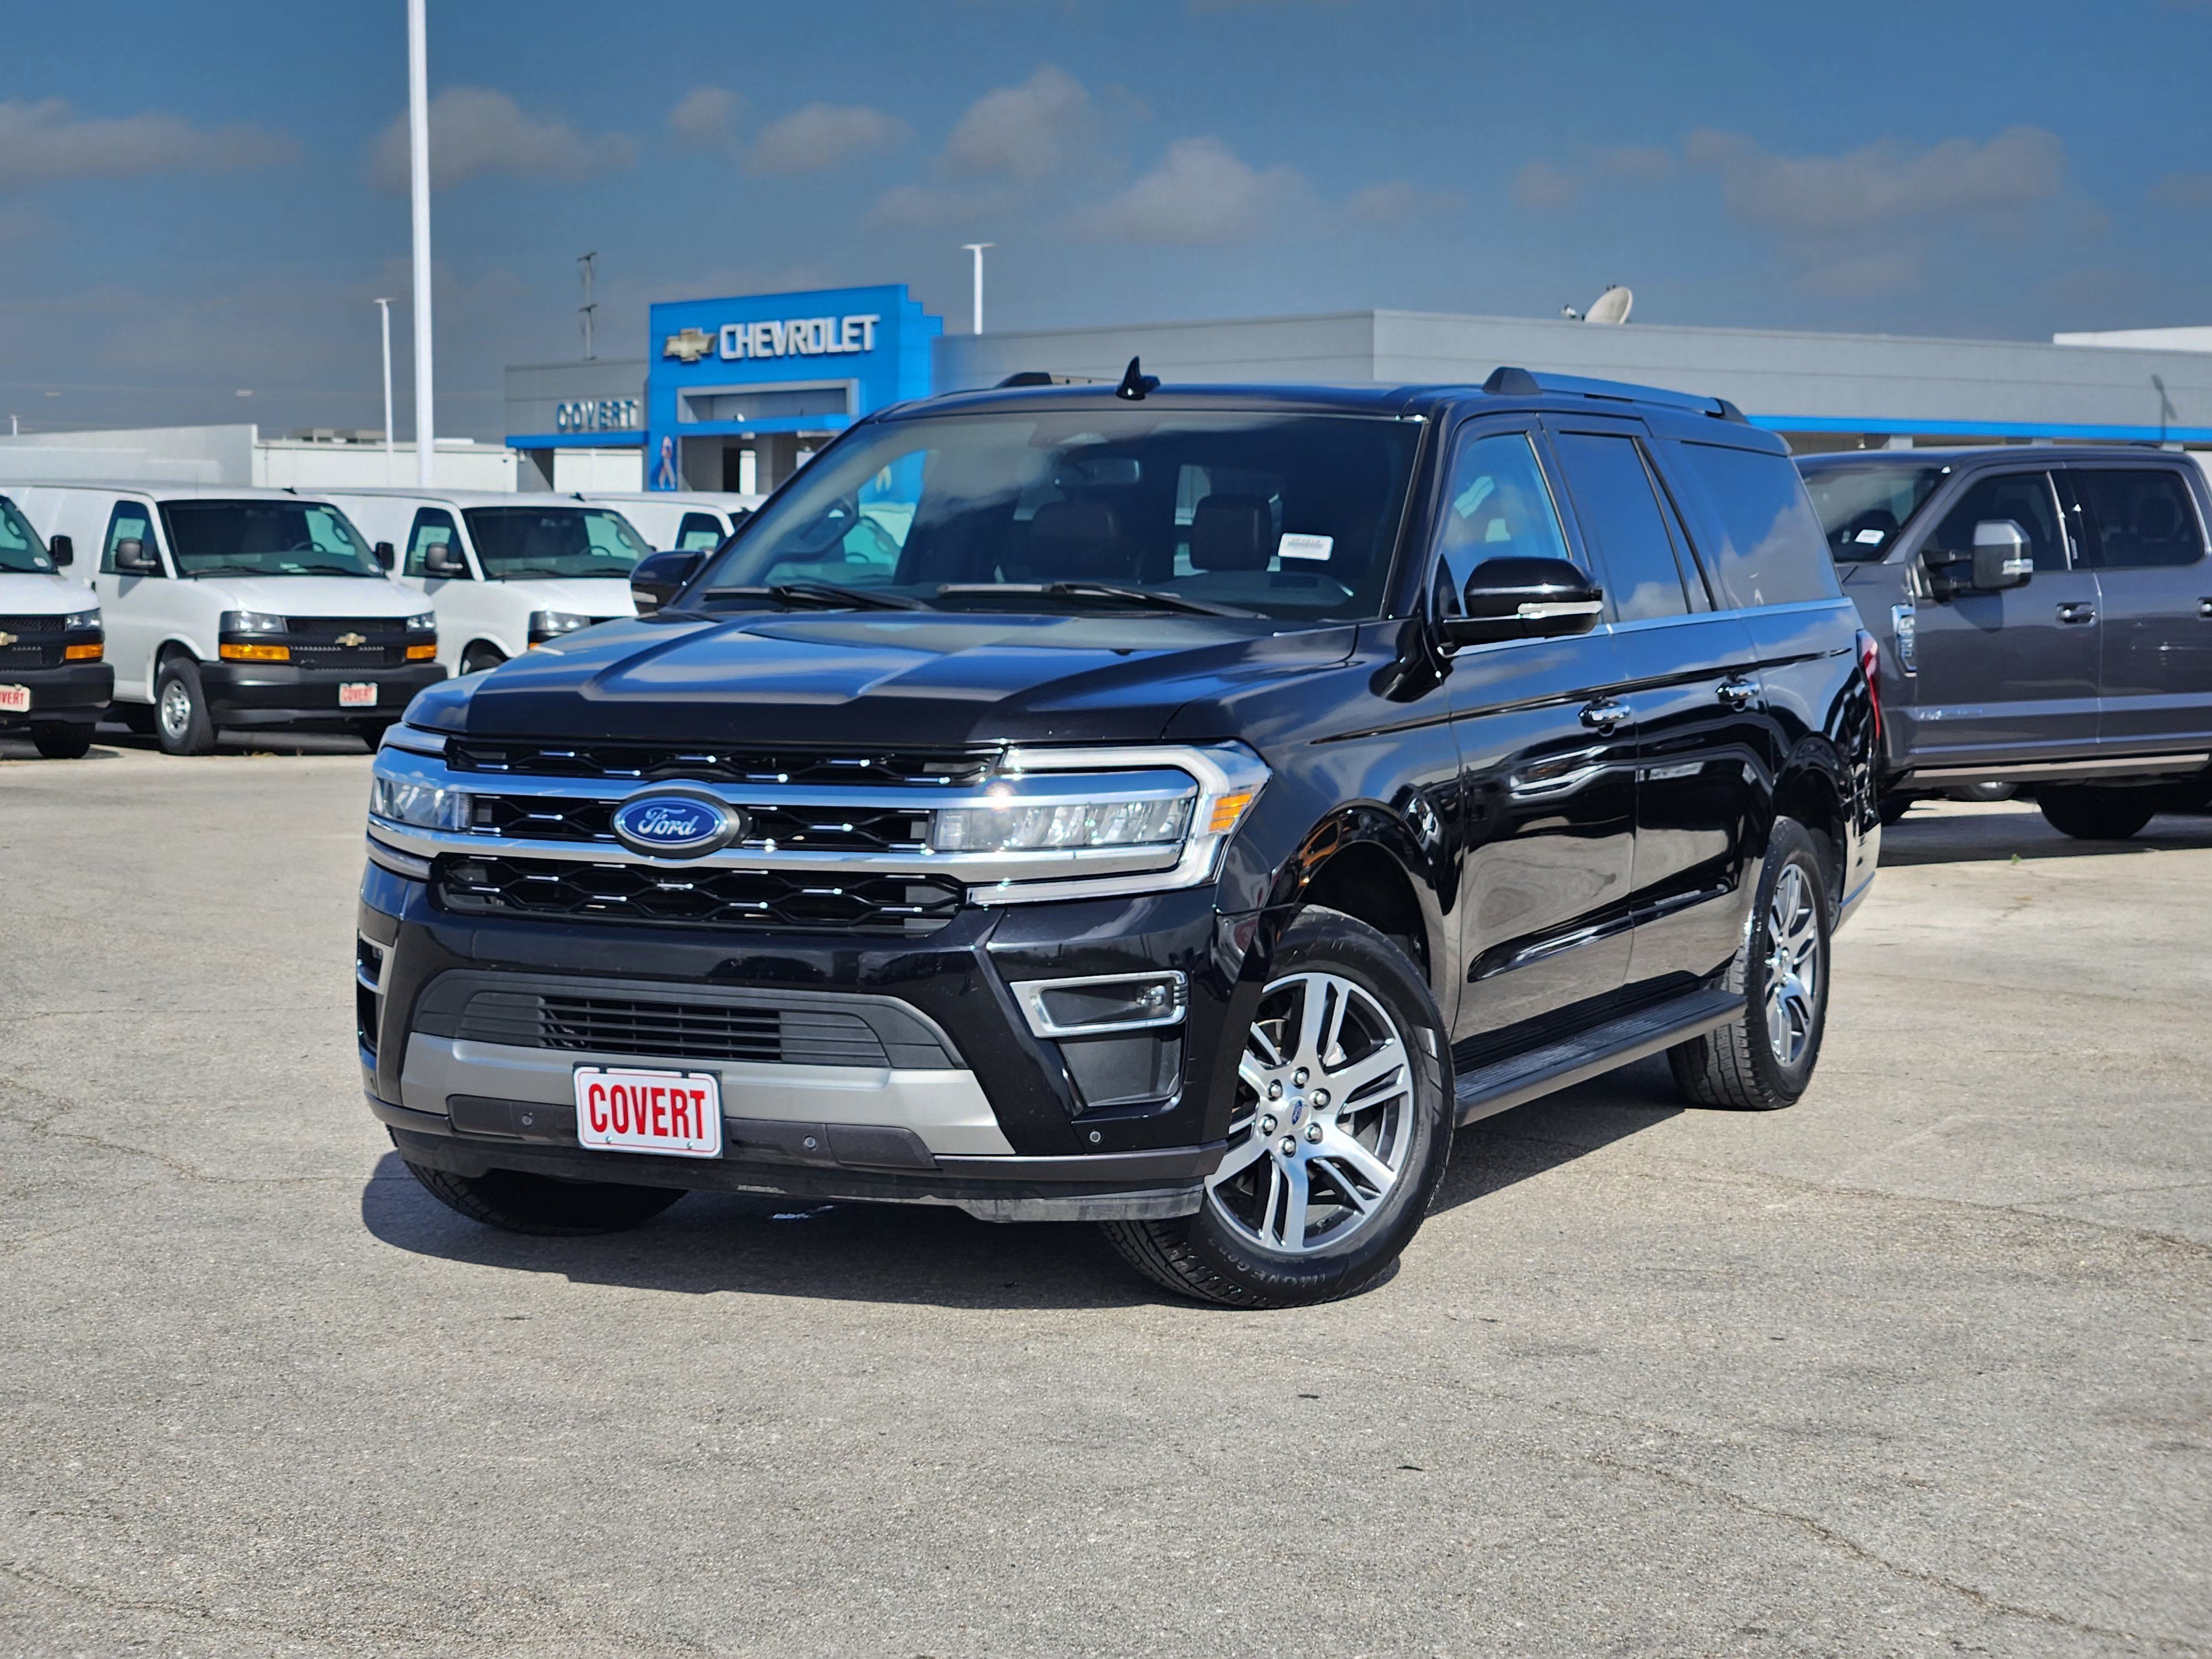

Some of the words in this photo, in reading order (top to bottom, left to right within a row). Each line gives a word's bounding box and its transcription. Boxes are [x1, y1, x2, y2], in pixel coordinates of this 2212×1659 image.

[719, 314, 881, 359] CHEVROLET
[557, 399, 639, 430] COVERT
[638, 807, 699, 836] Ford
[588, 1083, 706, 1139] COVERT
